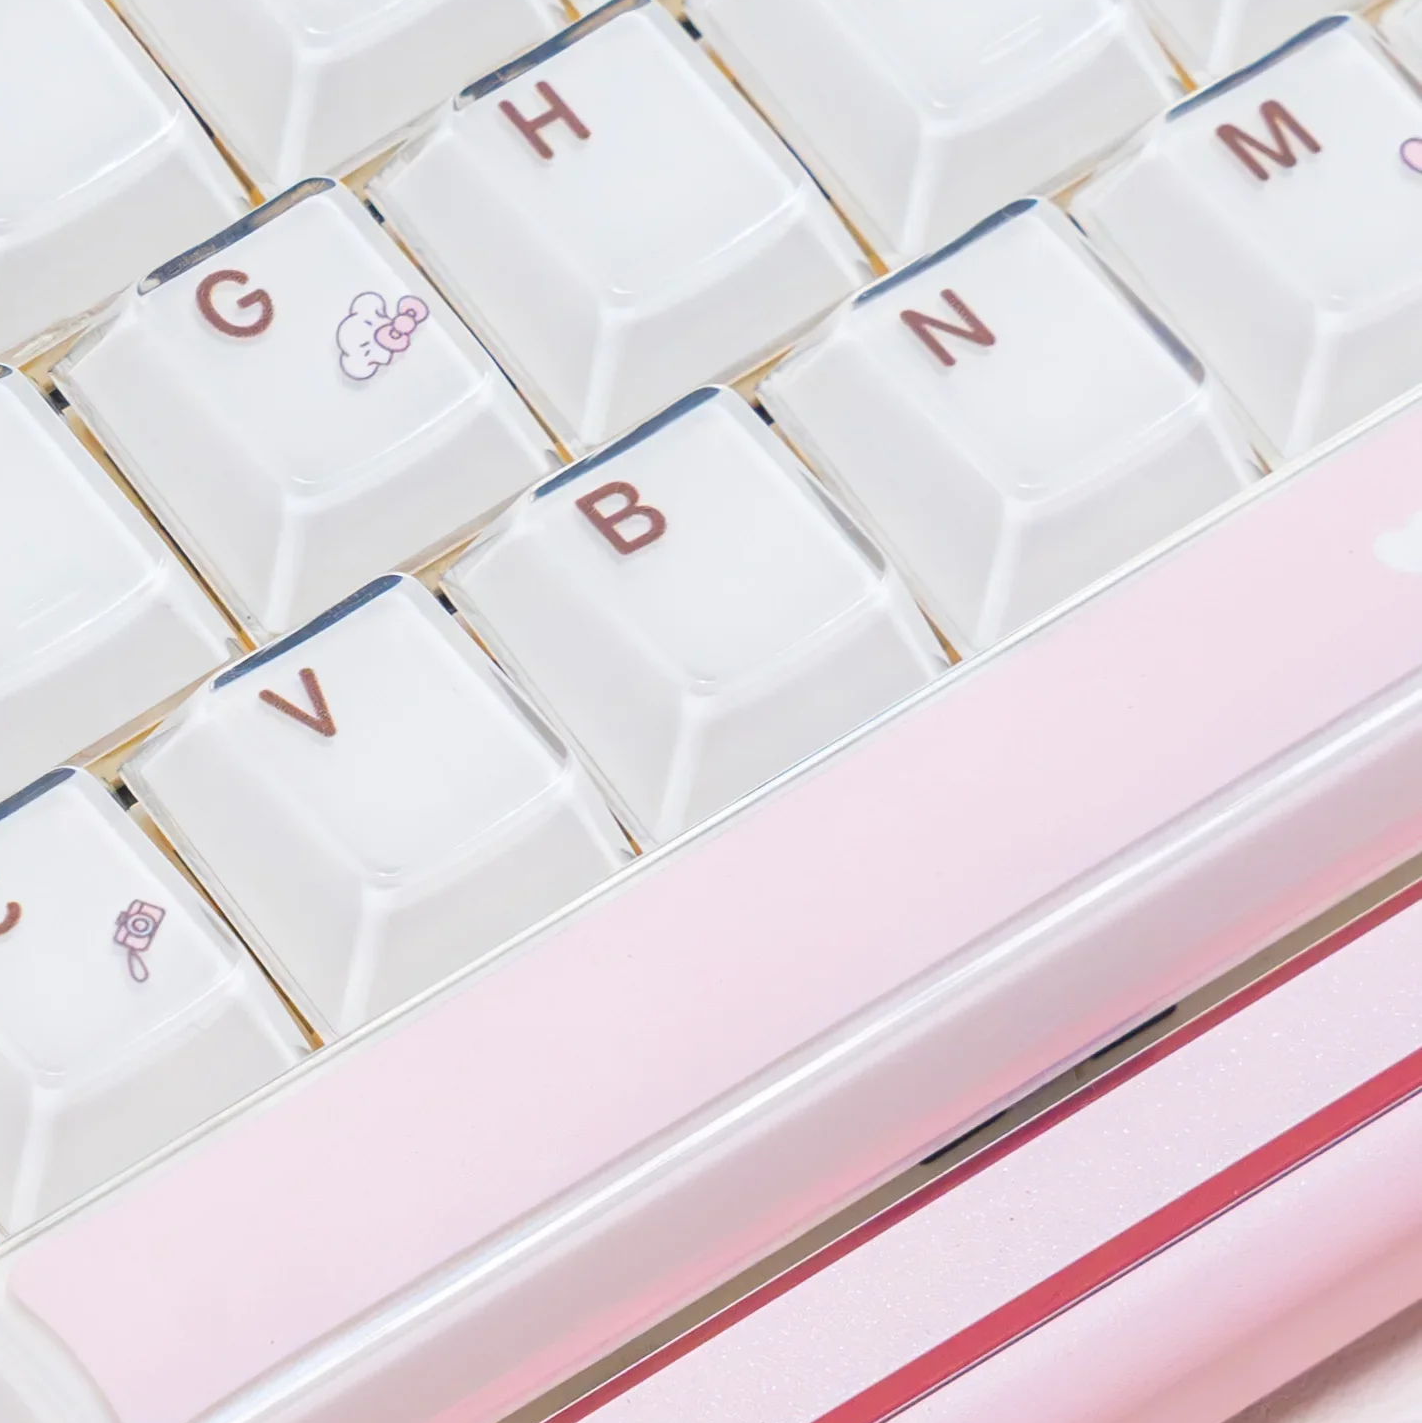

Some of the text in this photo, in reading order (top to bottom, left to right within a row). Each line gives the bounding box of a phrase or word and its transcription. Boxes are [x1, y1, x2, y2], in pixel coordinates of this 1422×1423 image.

[497, 80, 592, 161] H
[1215, 98, 1323, 183] M
[194, 268, 275, 339] G
[899, 287, 997, 368] N
[574, 480, 668, 557] B
[257, 666, 338, 739] V
